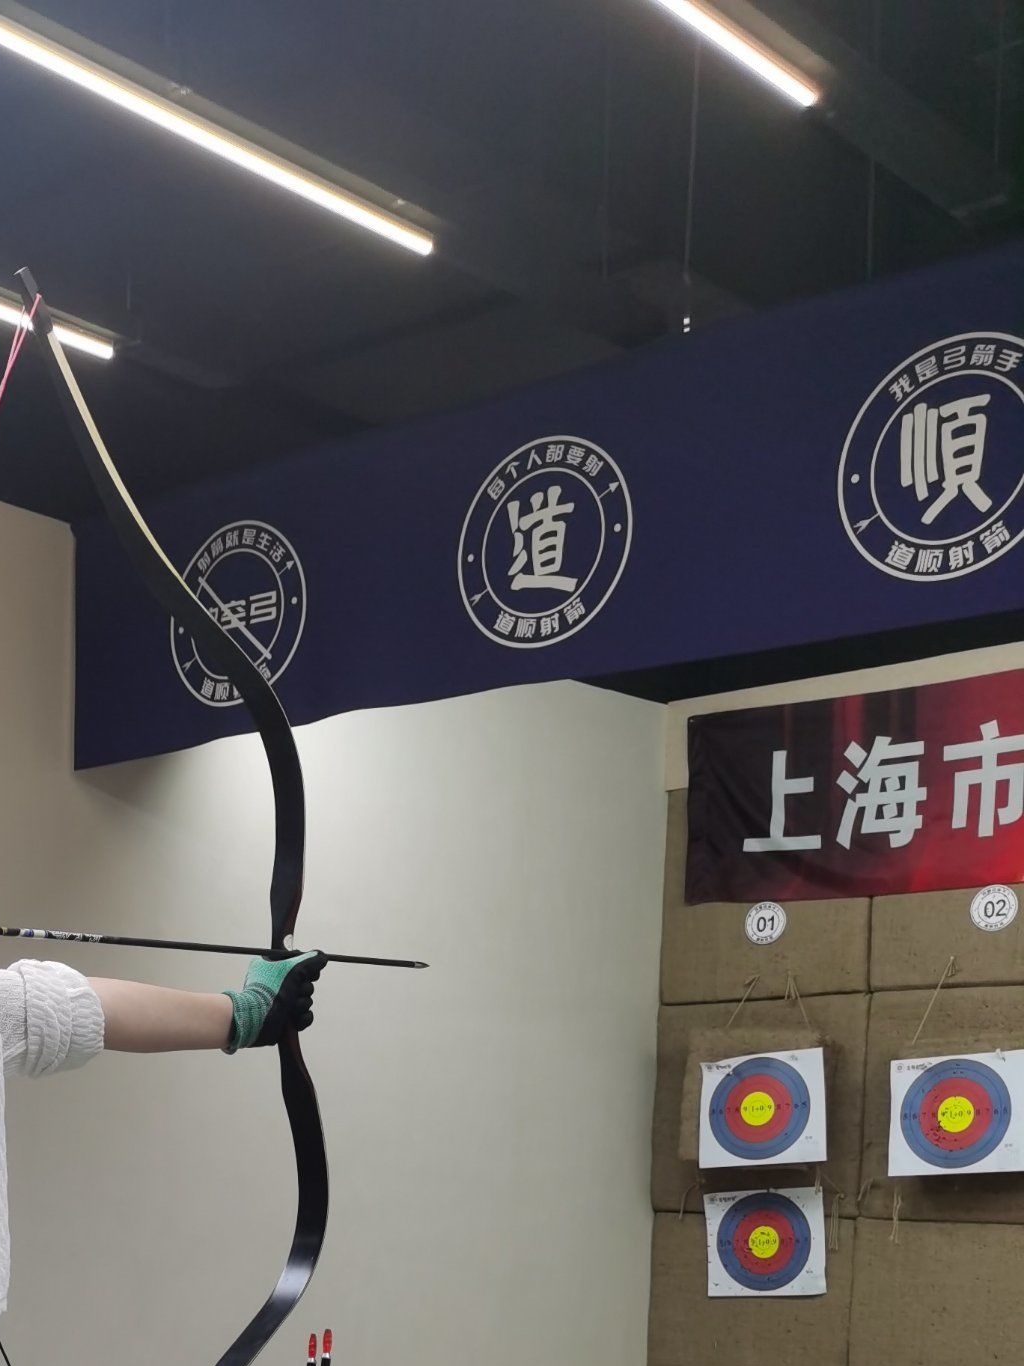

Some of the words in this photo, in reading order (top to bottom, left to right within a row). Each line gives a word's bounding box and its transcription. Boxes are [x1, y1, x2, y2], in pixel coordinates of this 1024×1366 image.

[888, 344, 1023, 402] 我是弓箭手
[197, 528, 286, 573] 射箭就是生活
[507, 485, 578, 592] 道
[884, 520, 1011, 573] 道顺射箭
[493, 597, 587, 639] 道顺射箭
[743, 720, 1024, 851] 上海市
[757, 915, 775, 932] 01
[984, 899, 1007, 918] 02
